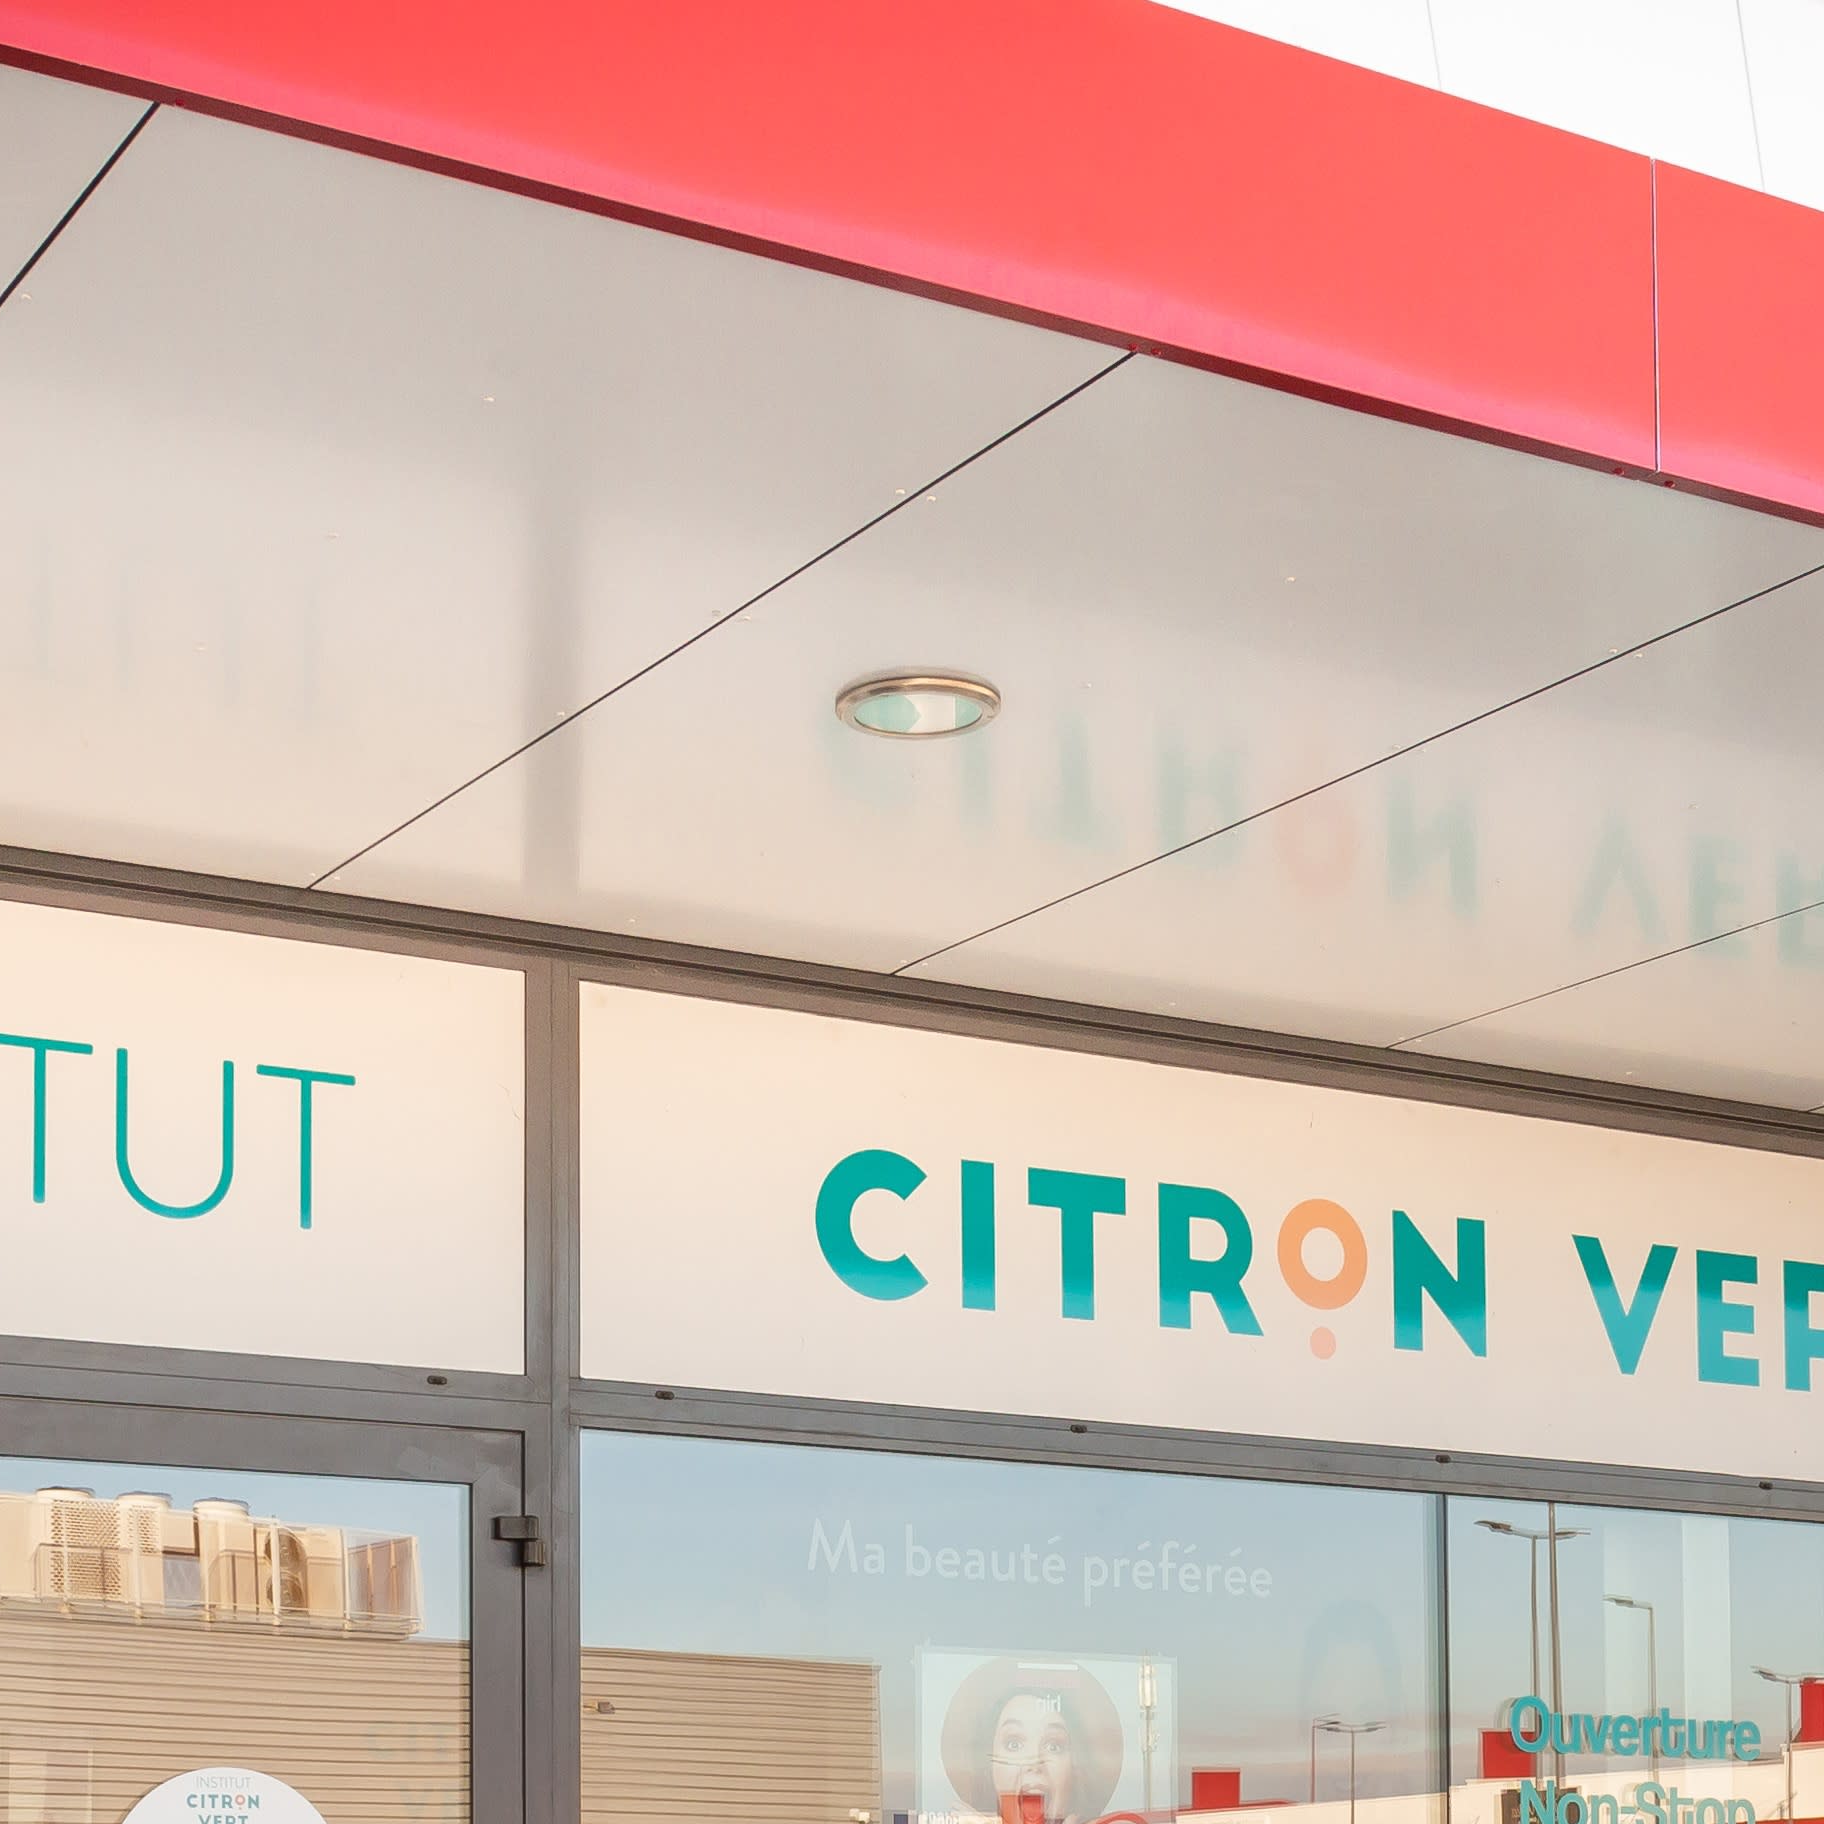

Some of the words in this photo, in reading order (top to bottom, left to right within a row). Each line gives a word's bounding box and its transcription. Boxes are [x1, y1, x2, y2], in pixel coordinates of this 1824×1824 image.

[814, 1148, 1487, 1360] CITRON
[807, 1516, 886, 1575] Ma
[904, 1523, 1067, 1586] beauté
[1082, 1540, 1273, 1607] préférée
[1510, 1695, 1762, 1762] Ouverture
[186, 1793, 261, 1810] CITRON
[193, 1775, 252, 1789] INSTITUT
